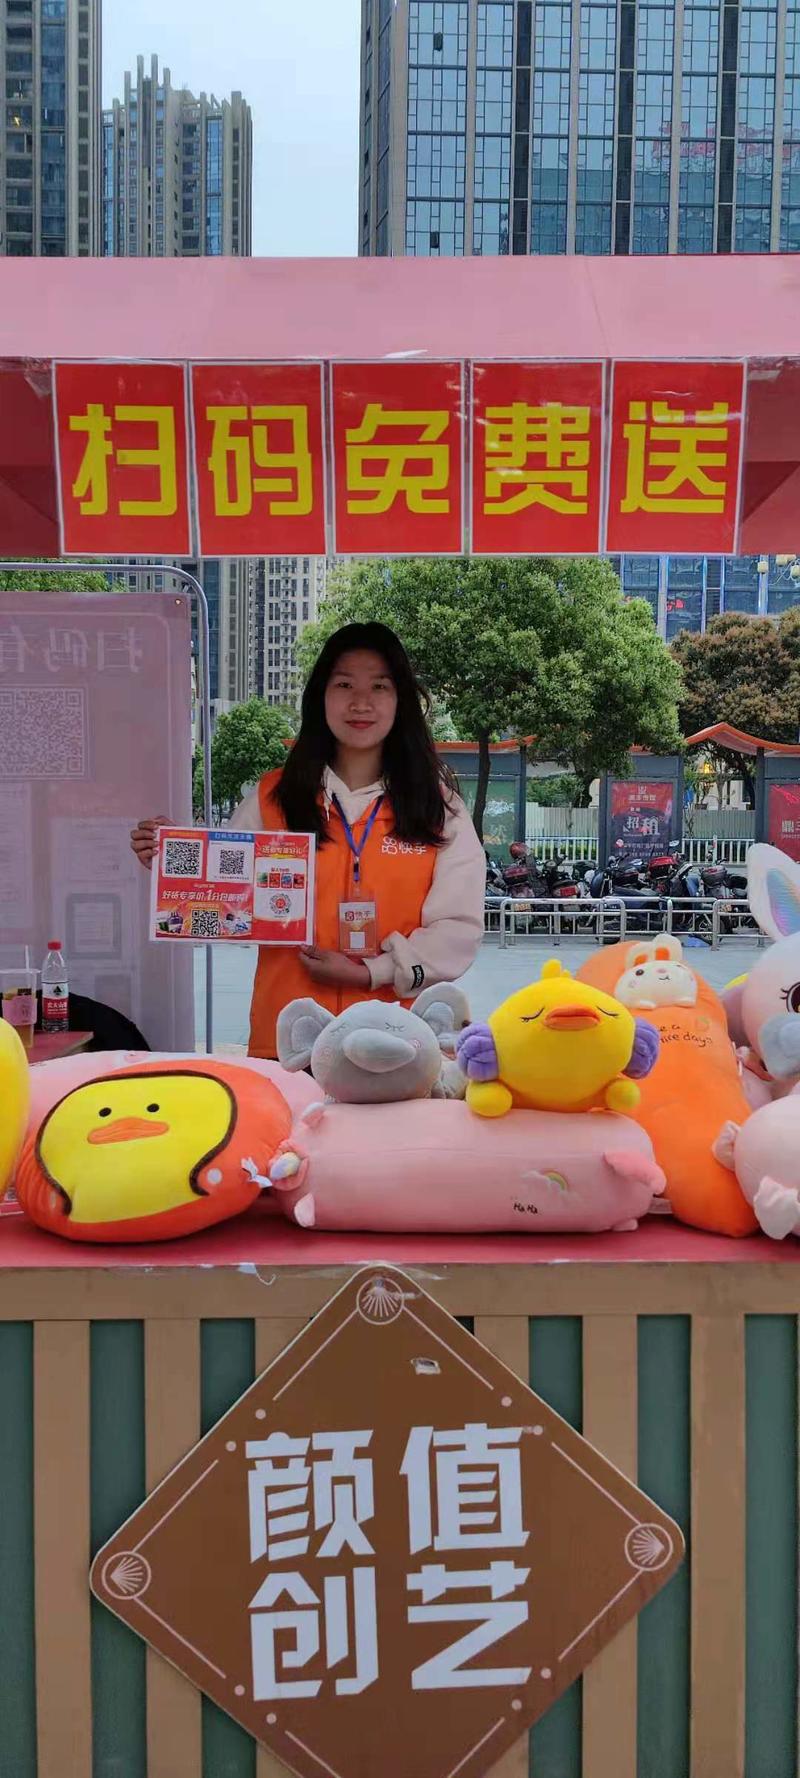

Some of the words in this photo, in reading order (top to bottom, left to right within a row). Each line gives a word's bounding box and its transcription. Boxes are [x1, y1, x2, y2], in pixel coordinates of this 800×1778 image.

[70, 401, 728, 517] 扫码免费送
[399, 841, 427, 854] 快手
[245, 1422, 531, 1564] 颜值
[247, 1560, 533, 1702] 创艺
